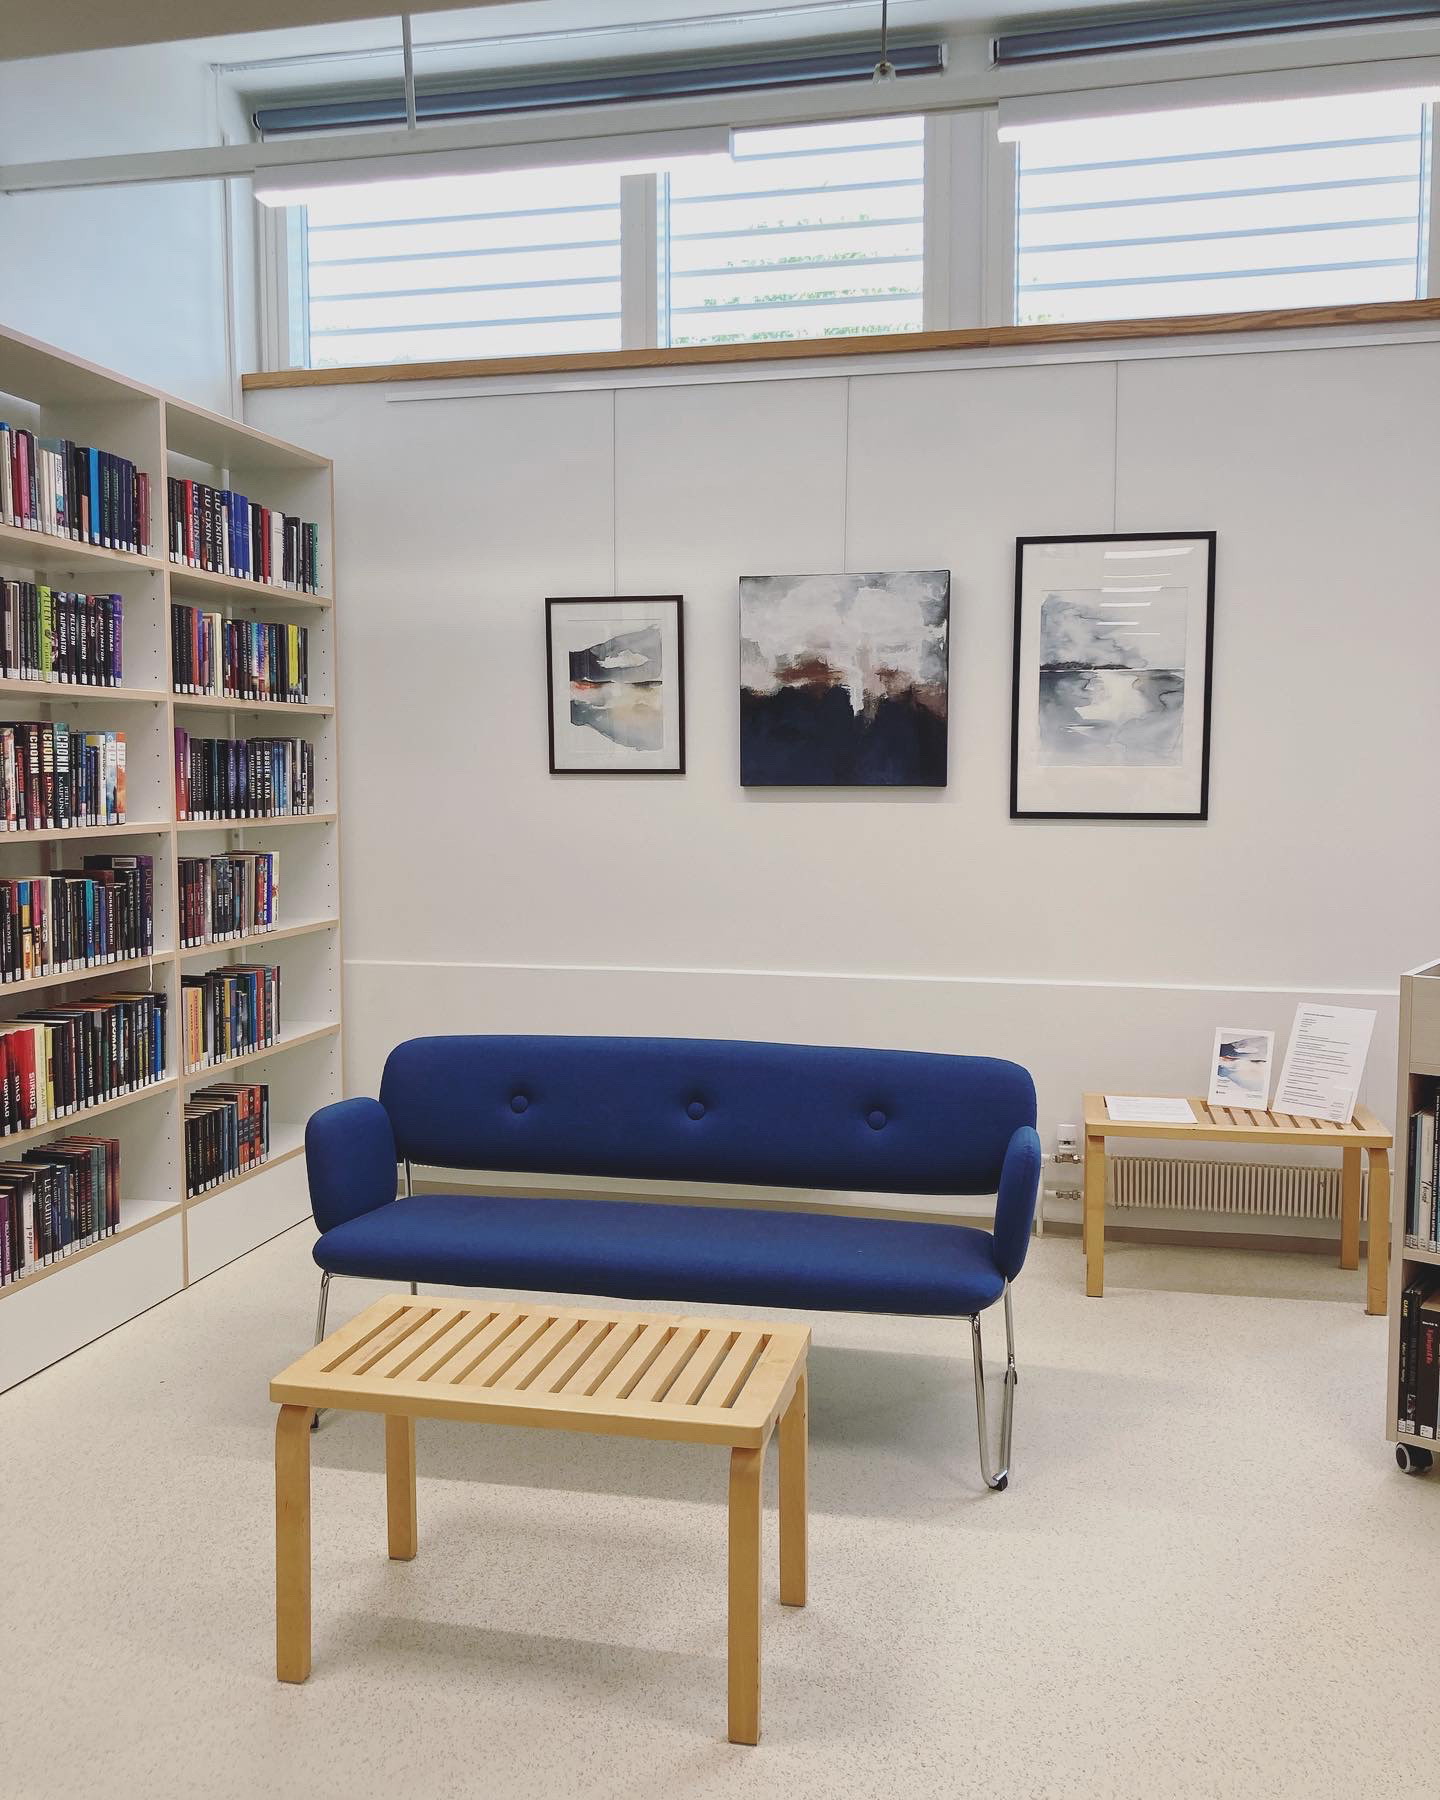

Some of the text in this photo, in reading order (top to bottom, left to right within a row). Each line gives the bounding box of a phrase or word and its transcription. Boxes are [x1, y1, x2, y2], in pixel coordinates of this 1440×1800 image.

[29, 736, 39, 774] CRONIN
[43, 734, 54, 773] CRONIN
[56, 735, 69, 773] CRONIN
[28, 1072, 36, 1110] SIIRROS
[44, 1178, 51, 1193] LE
